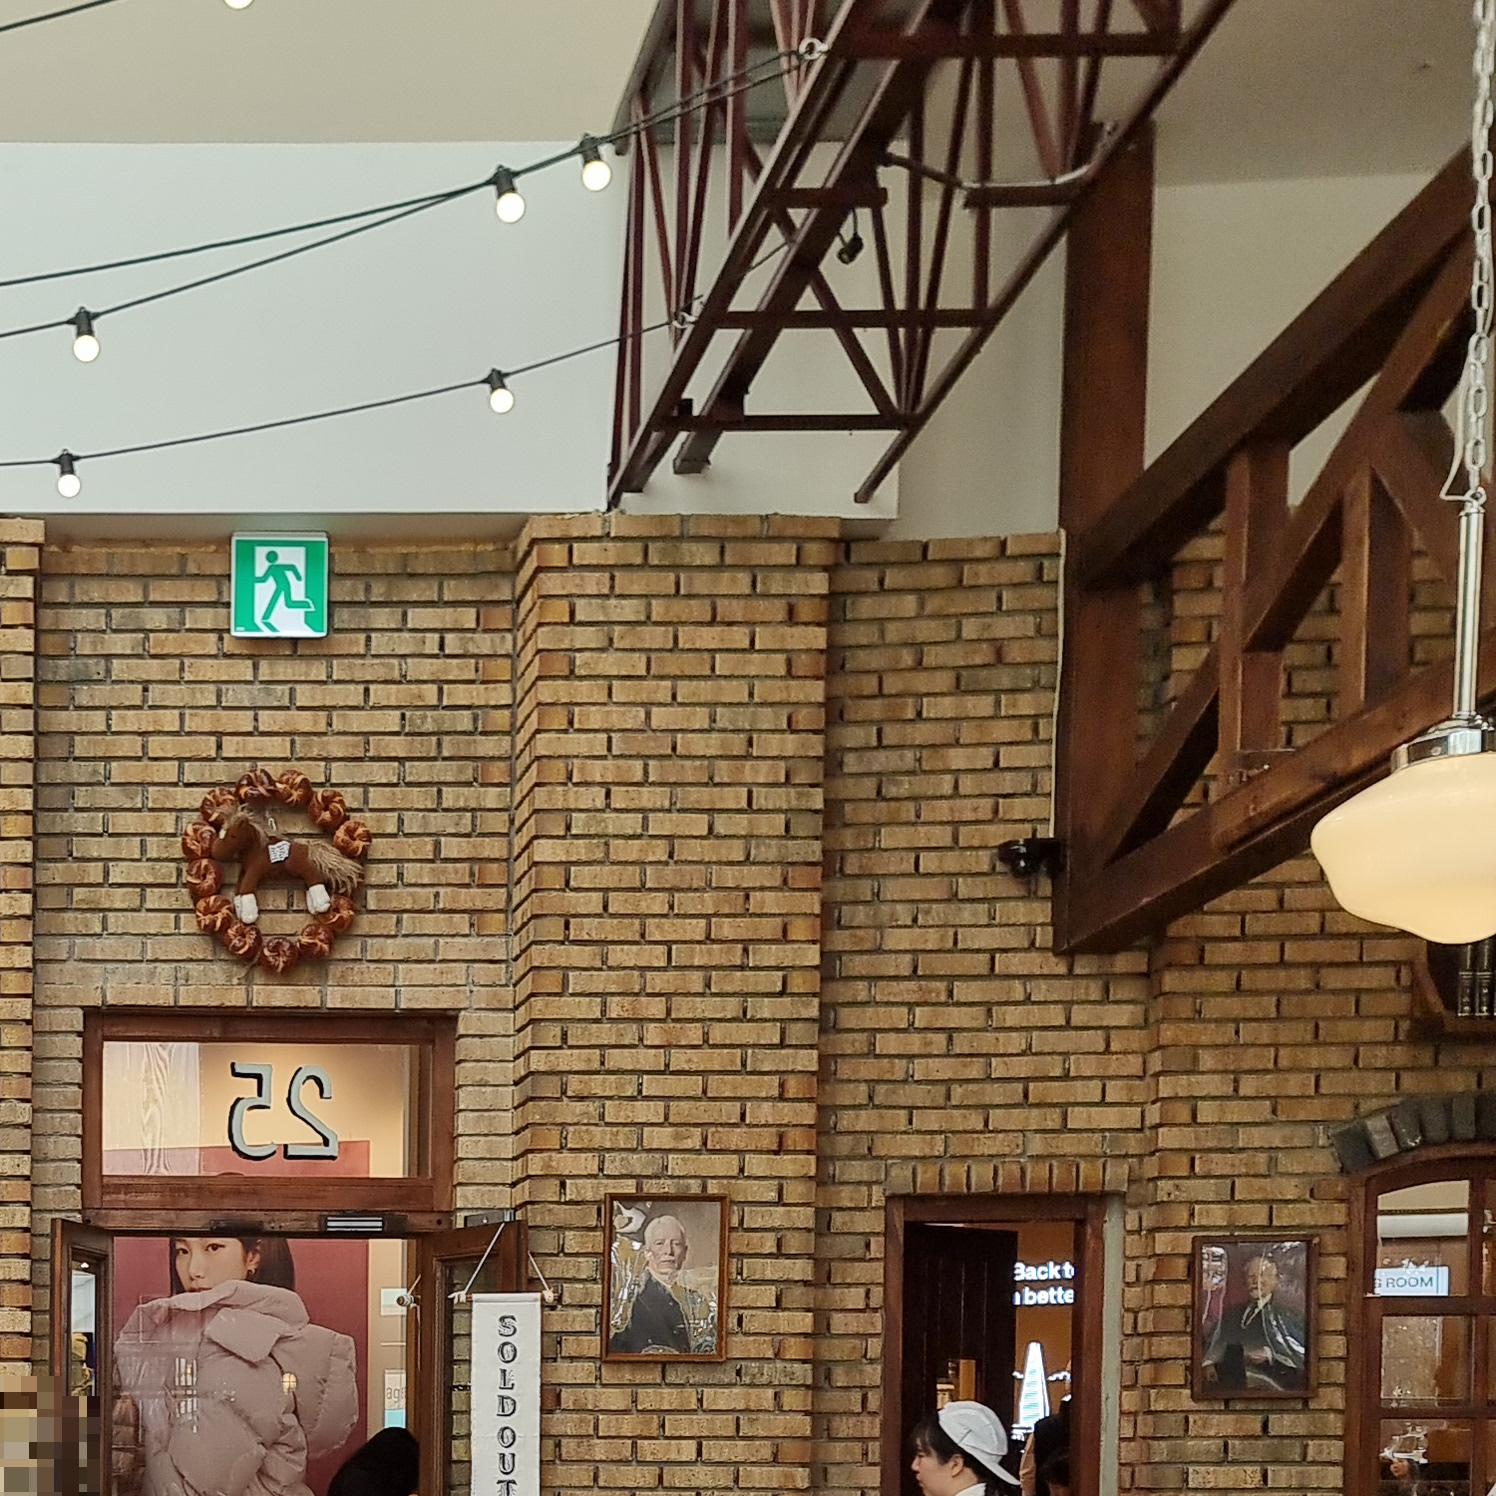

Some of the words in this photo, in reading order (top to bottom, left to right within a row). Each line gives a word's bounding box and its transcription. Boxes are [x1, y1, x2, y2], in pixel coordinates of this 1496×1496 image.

[1013, 1261, 1061, 1281] Back
[1386, 1276, 1433, 1288] ROOM
[497, 1315, 518, 1417] SOLD
